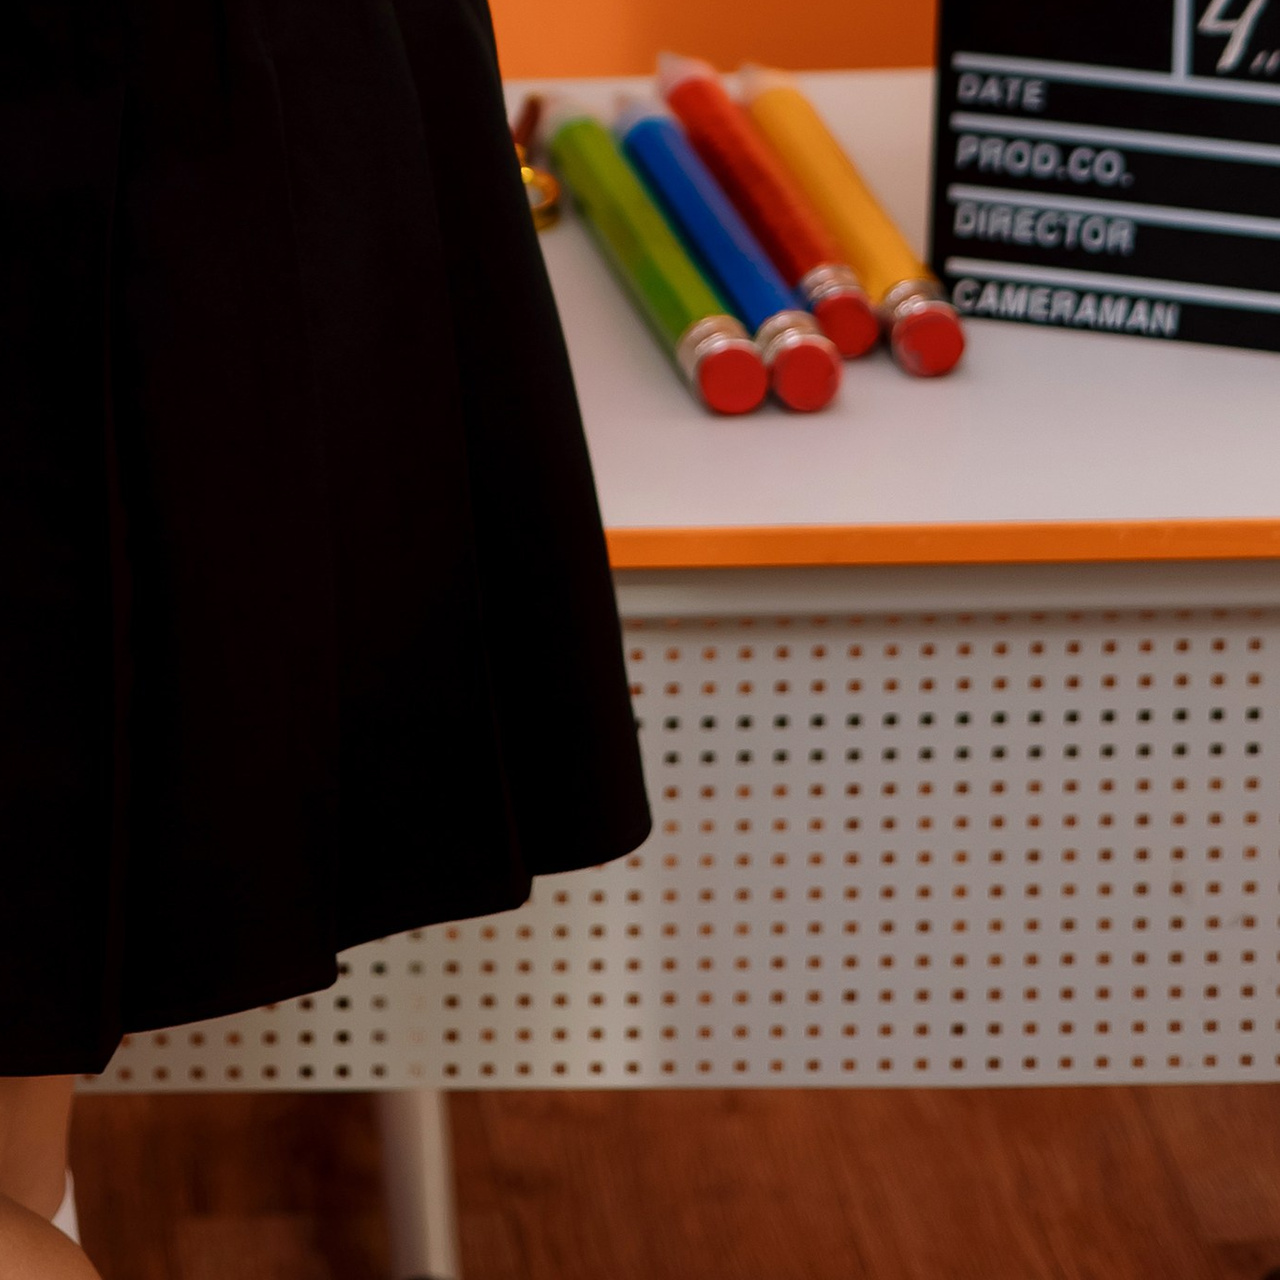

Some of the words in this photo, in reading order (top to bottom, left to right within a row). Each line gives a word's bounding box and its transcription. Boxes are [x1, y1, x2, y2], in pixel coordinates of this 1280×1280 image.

[958, 73, 1045, 110] DATE
[956, 135, 1134, 186] PROD.CO.
[955, 202, 1135, 255] DIRECTOR
[953, 279, 1178, 335] CAMERAMAN
